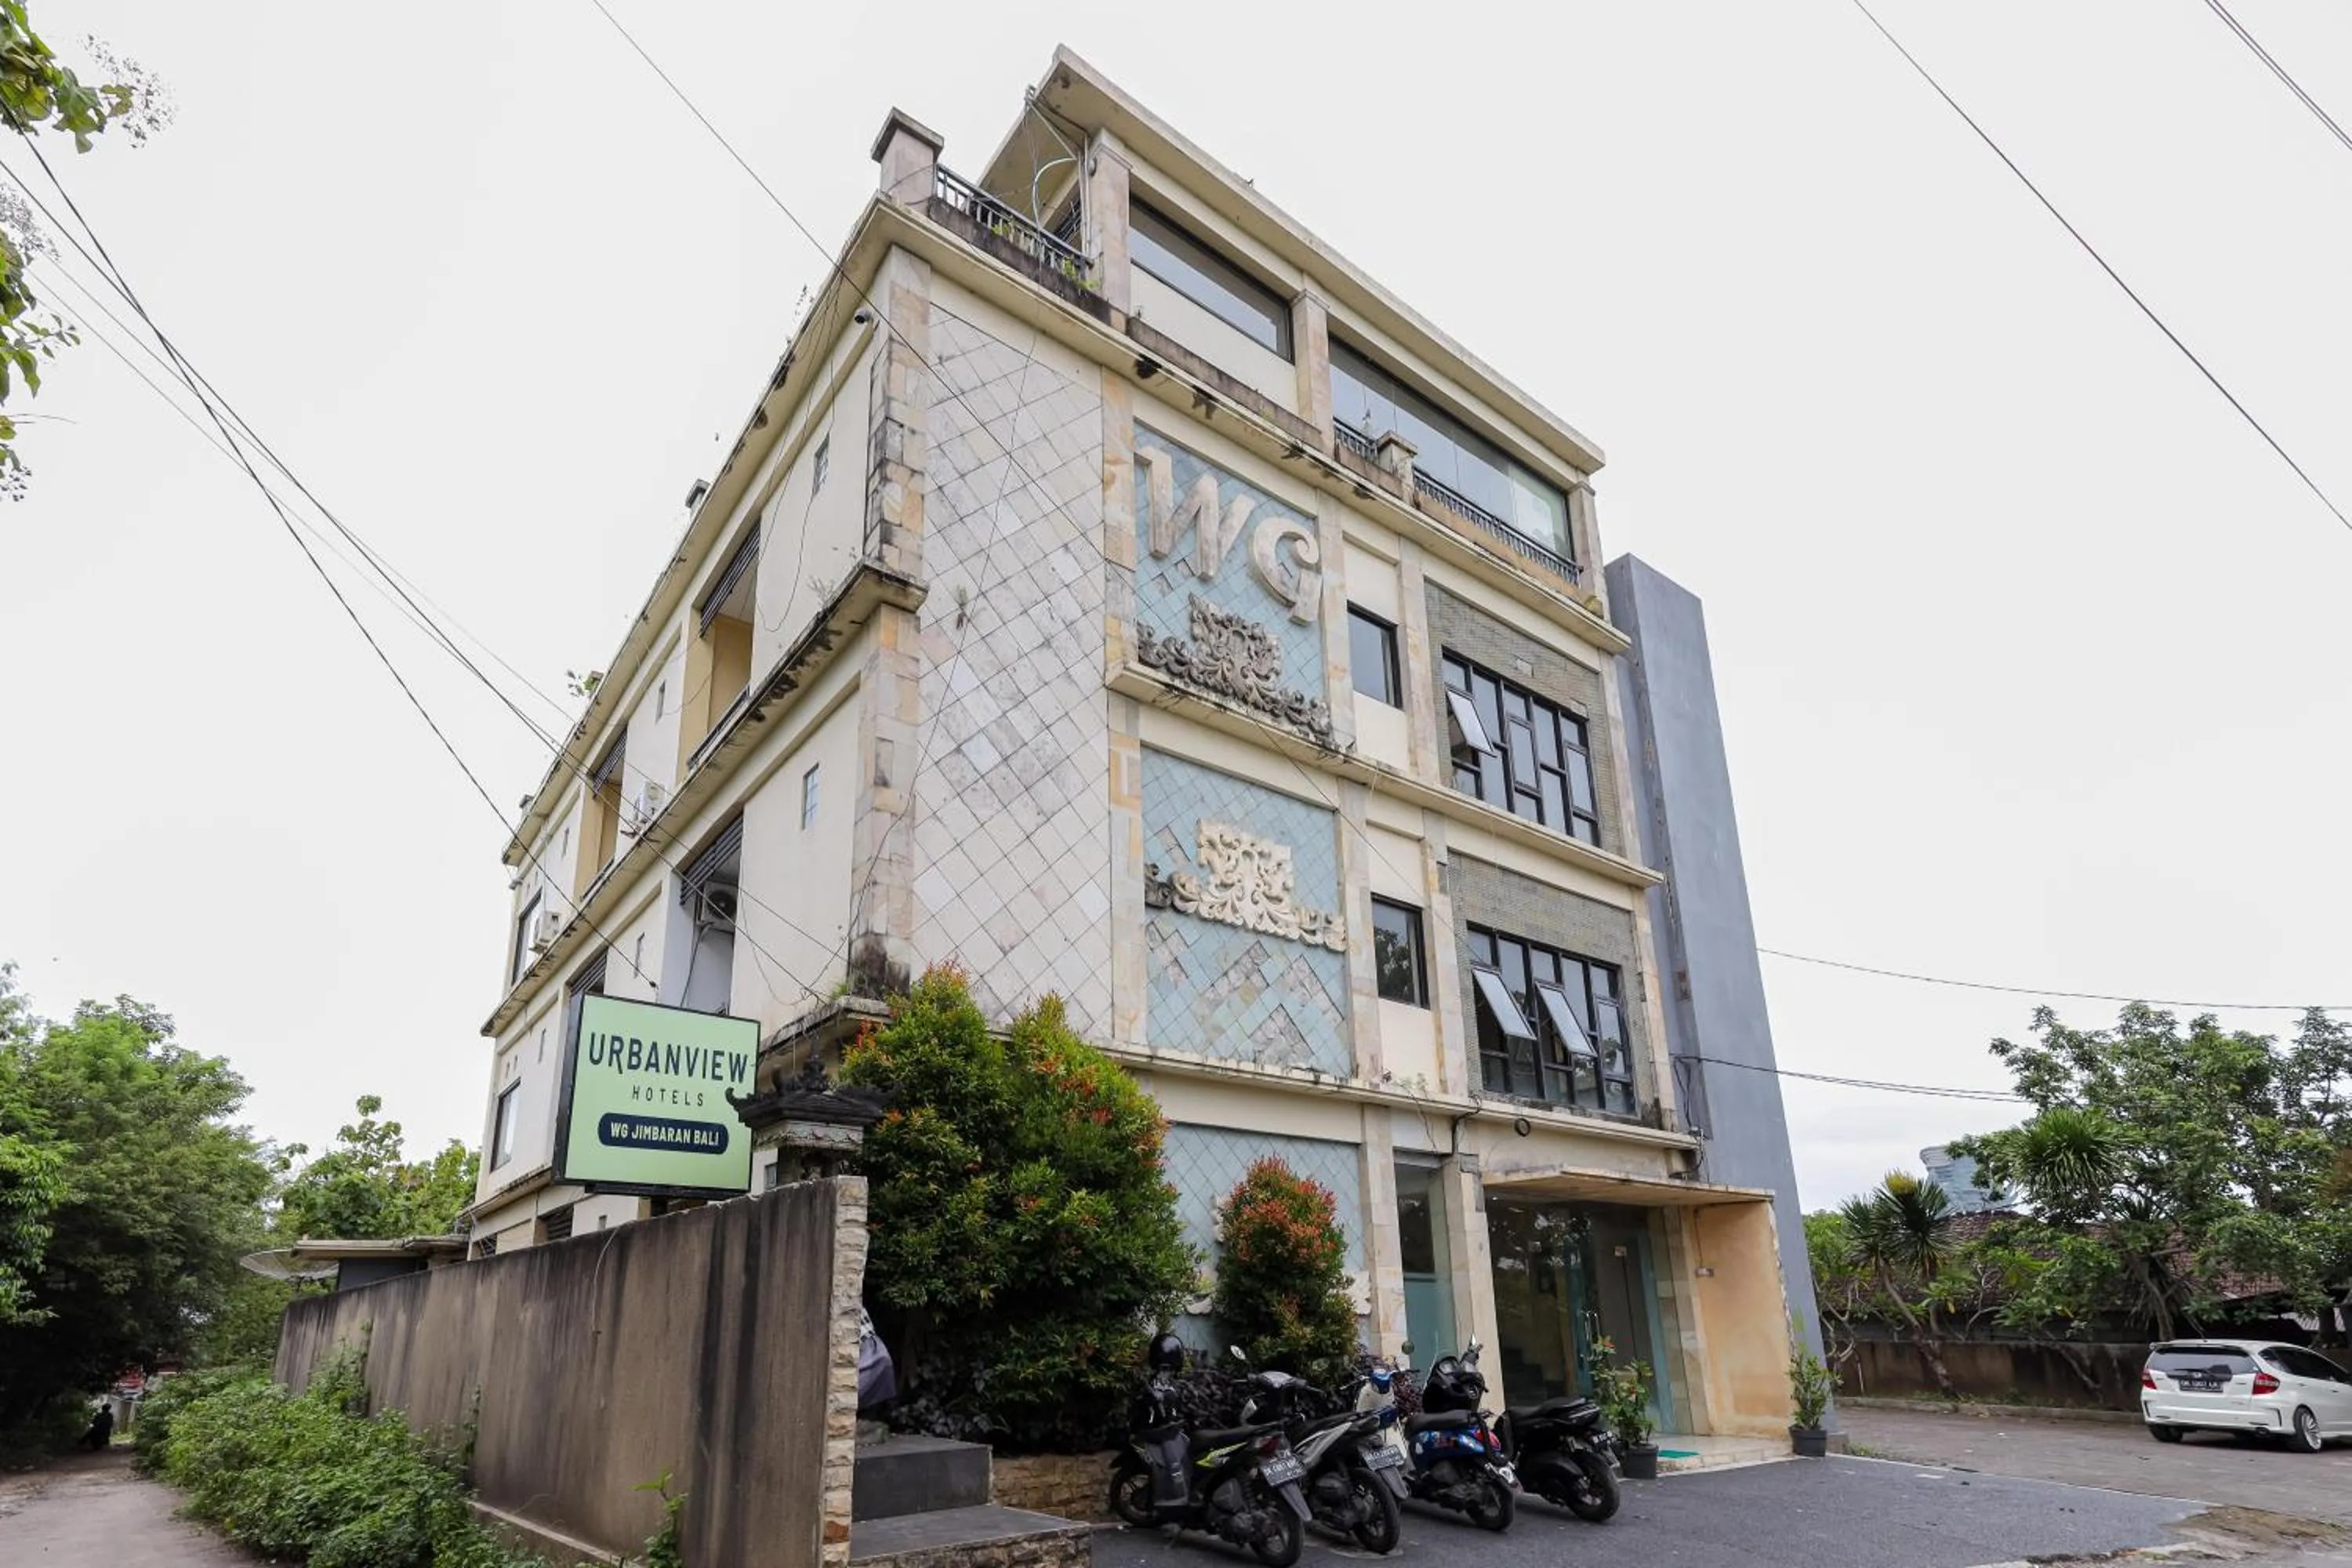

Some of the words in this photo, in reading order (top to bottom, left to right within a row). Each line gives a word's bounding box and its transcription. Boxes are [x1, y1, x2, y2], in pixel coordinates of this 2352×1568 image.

[1134, 446, 1323, 626] WG
[589, 1032, 748, 1083] URBANVIEW
[632, 1085, 704, 1106] HOTELS
[611, 1122, 628, 1138] WG
[631, 1124, 691, 1144] JIMBARAN
[694, 1130, 719, 1146] BALI
